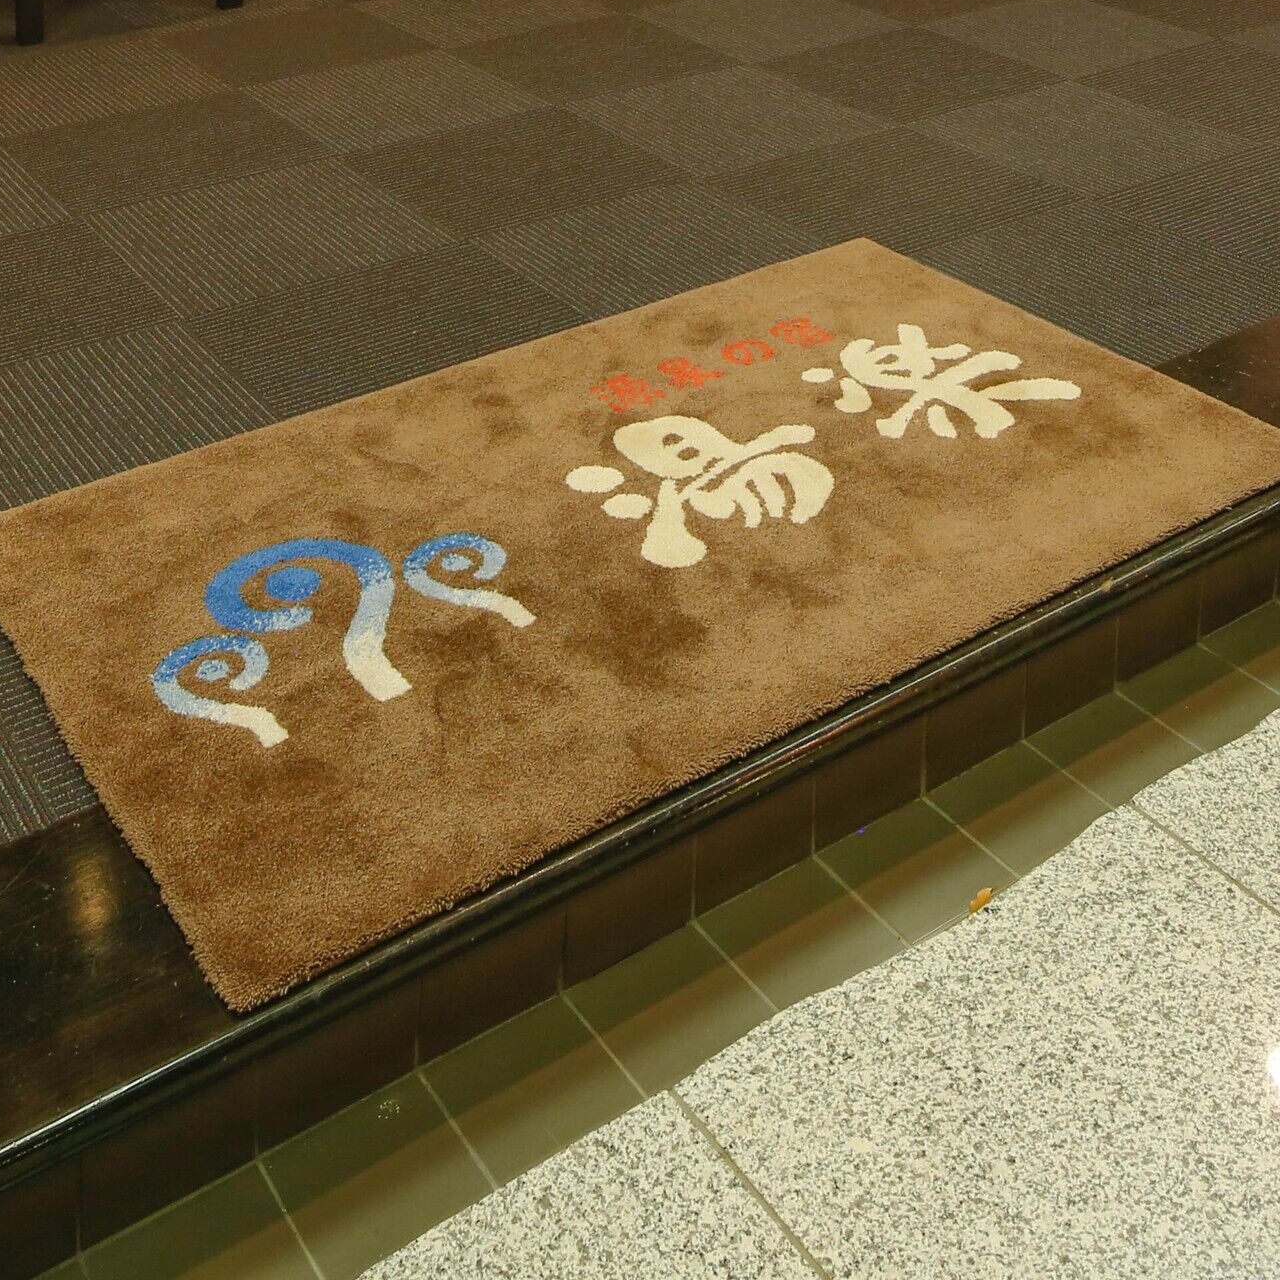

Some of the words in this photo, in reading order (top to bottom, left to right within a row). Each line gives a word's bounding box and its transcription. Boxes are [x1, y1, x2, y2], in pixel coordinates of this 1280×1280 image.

[565, 323, 1081, 569] 湯楽
[591, 317, 834, 413] 源泉の宿
